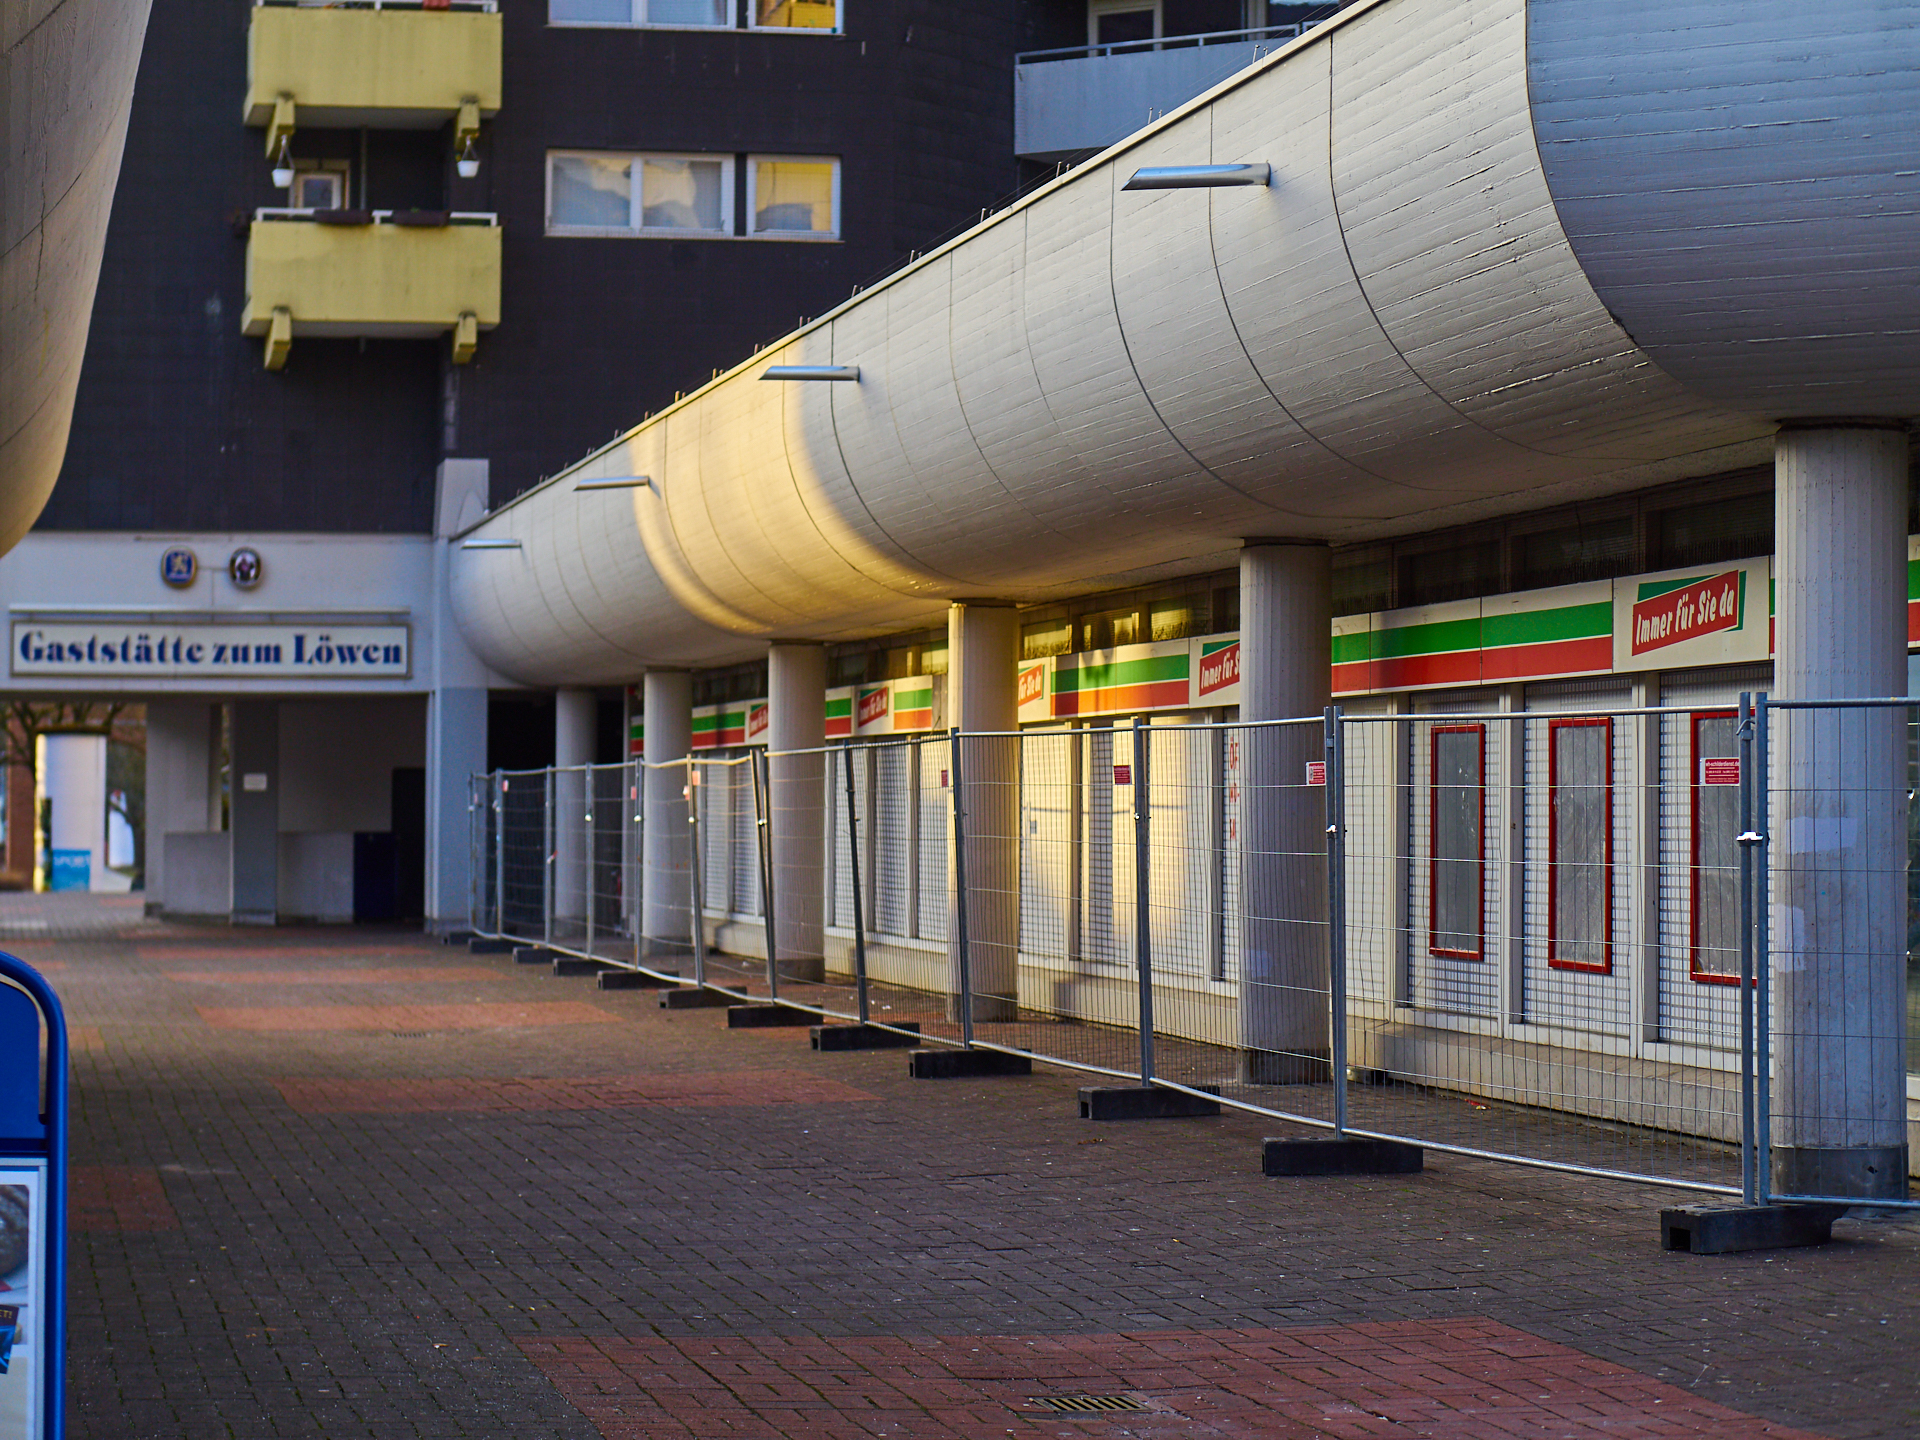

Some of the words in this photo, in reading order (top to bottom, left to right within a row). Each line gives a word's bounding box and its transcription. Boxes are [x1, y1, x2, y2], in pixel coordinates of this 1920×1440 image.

[1636, 613, 1673, 646] Immer
[1675, 592, 1695, 633] für
[1697, 589, 1717, 626] Sie
[1719, 583, 1735, 618] da
[20, 630, 204, 664] Gaststätte
[212, 642, 282, 664] zum
[294, 634, 402, 664] Löwen
[1201, 664, 1222, 690] Immer
[1222, 651, 1234, 681] für
[1234, 649, 1240, 676] S
